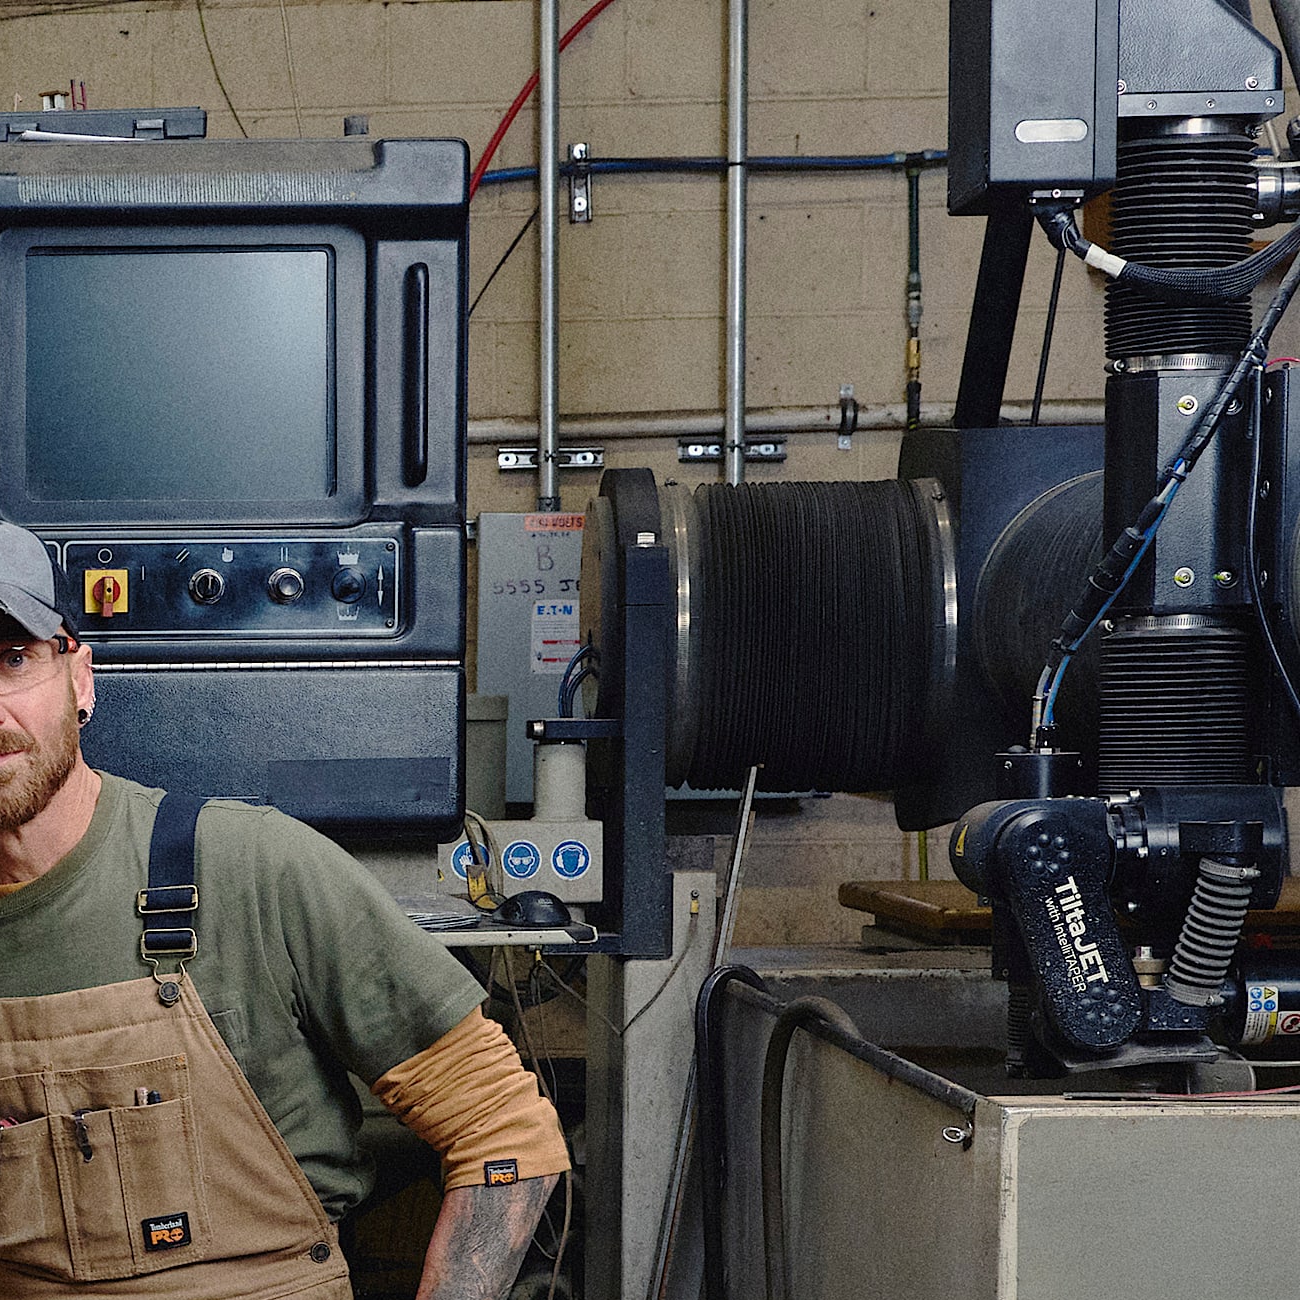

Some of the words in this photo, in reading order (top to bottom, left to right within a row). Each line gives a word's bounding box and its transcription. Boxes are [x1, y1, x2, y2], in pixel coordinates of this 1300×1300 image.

[537, 545, 554, 571] B
[493, 579, 545, 595] 5555
[1044, 896, 1061, 923] with
[1054, 875, 1110, 984] TiltaJET
[149, 1218, 183, 1231] Timberland
